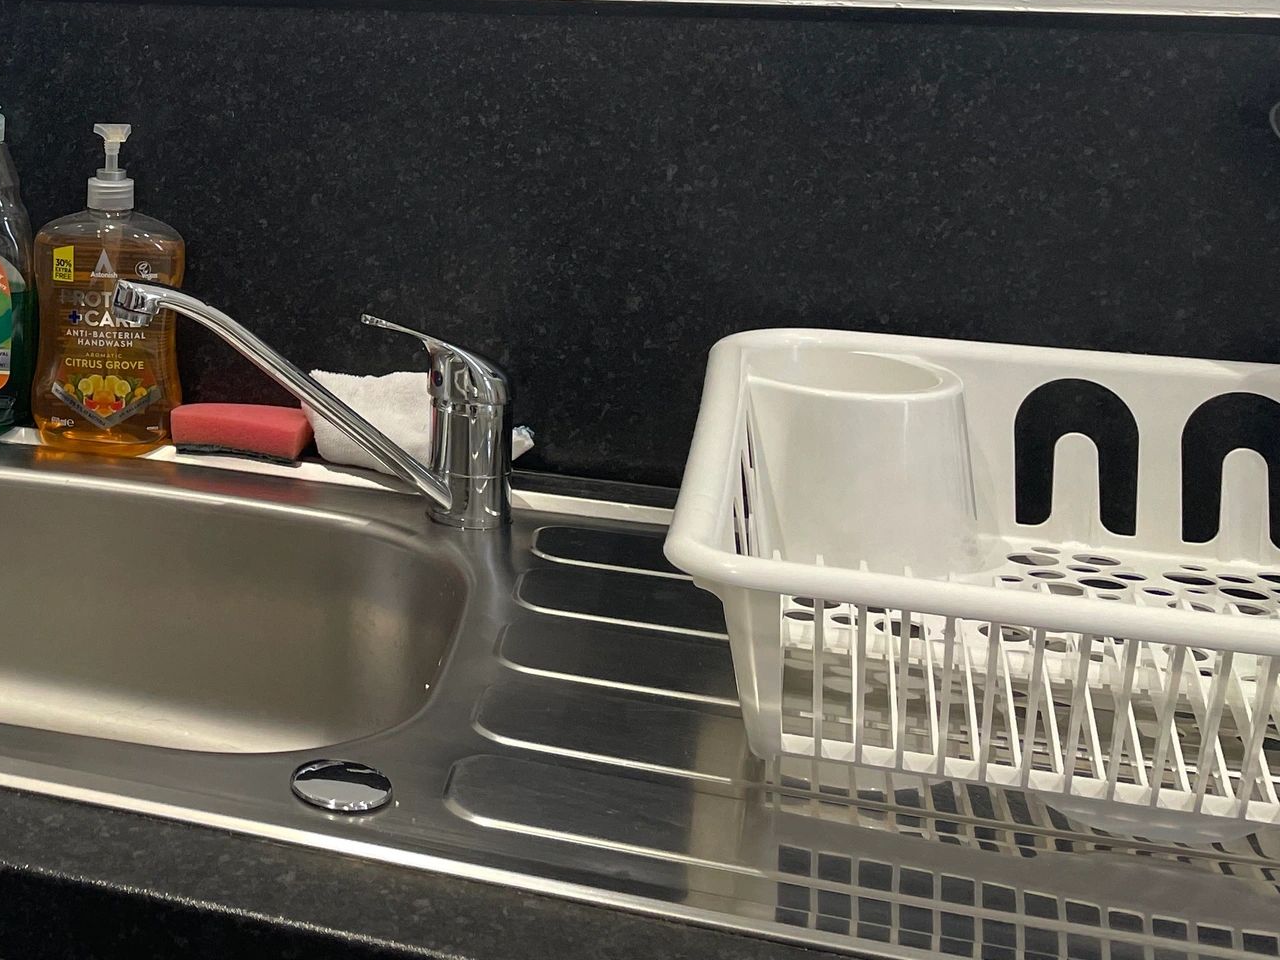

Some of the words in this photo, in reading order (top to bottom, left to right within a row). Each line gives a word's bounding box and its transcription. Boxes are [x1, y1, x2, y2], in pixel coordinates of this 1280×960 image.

[55, 258, 72, 267] 30%
[55, 272, 72, 280] FREE
[90, 270, 118, 279] Astonish
[60, 288, 112, 308] PROT
[66, 328, 146, 340] ANTI-BACTERIAL
[77, 338, 133, 348] HANDWASH
[65, 357, 103, 369] CITRUS
[105, 360, 145, 370] GROVE
